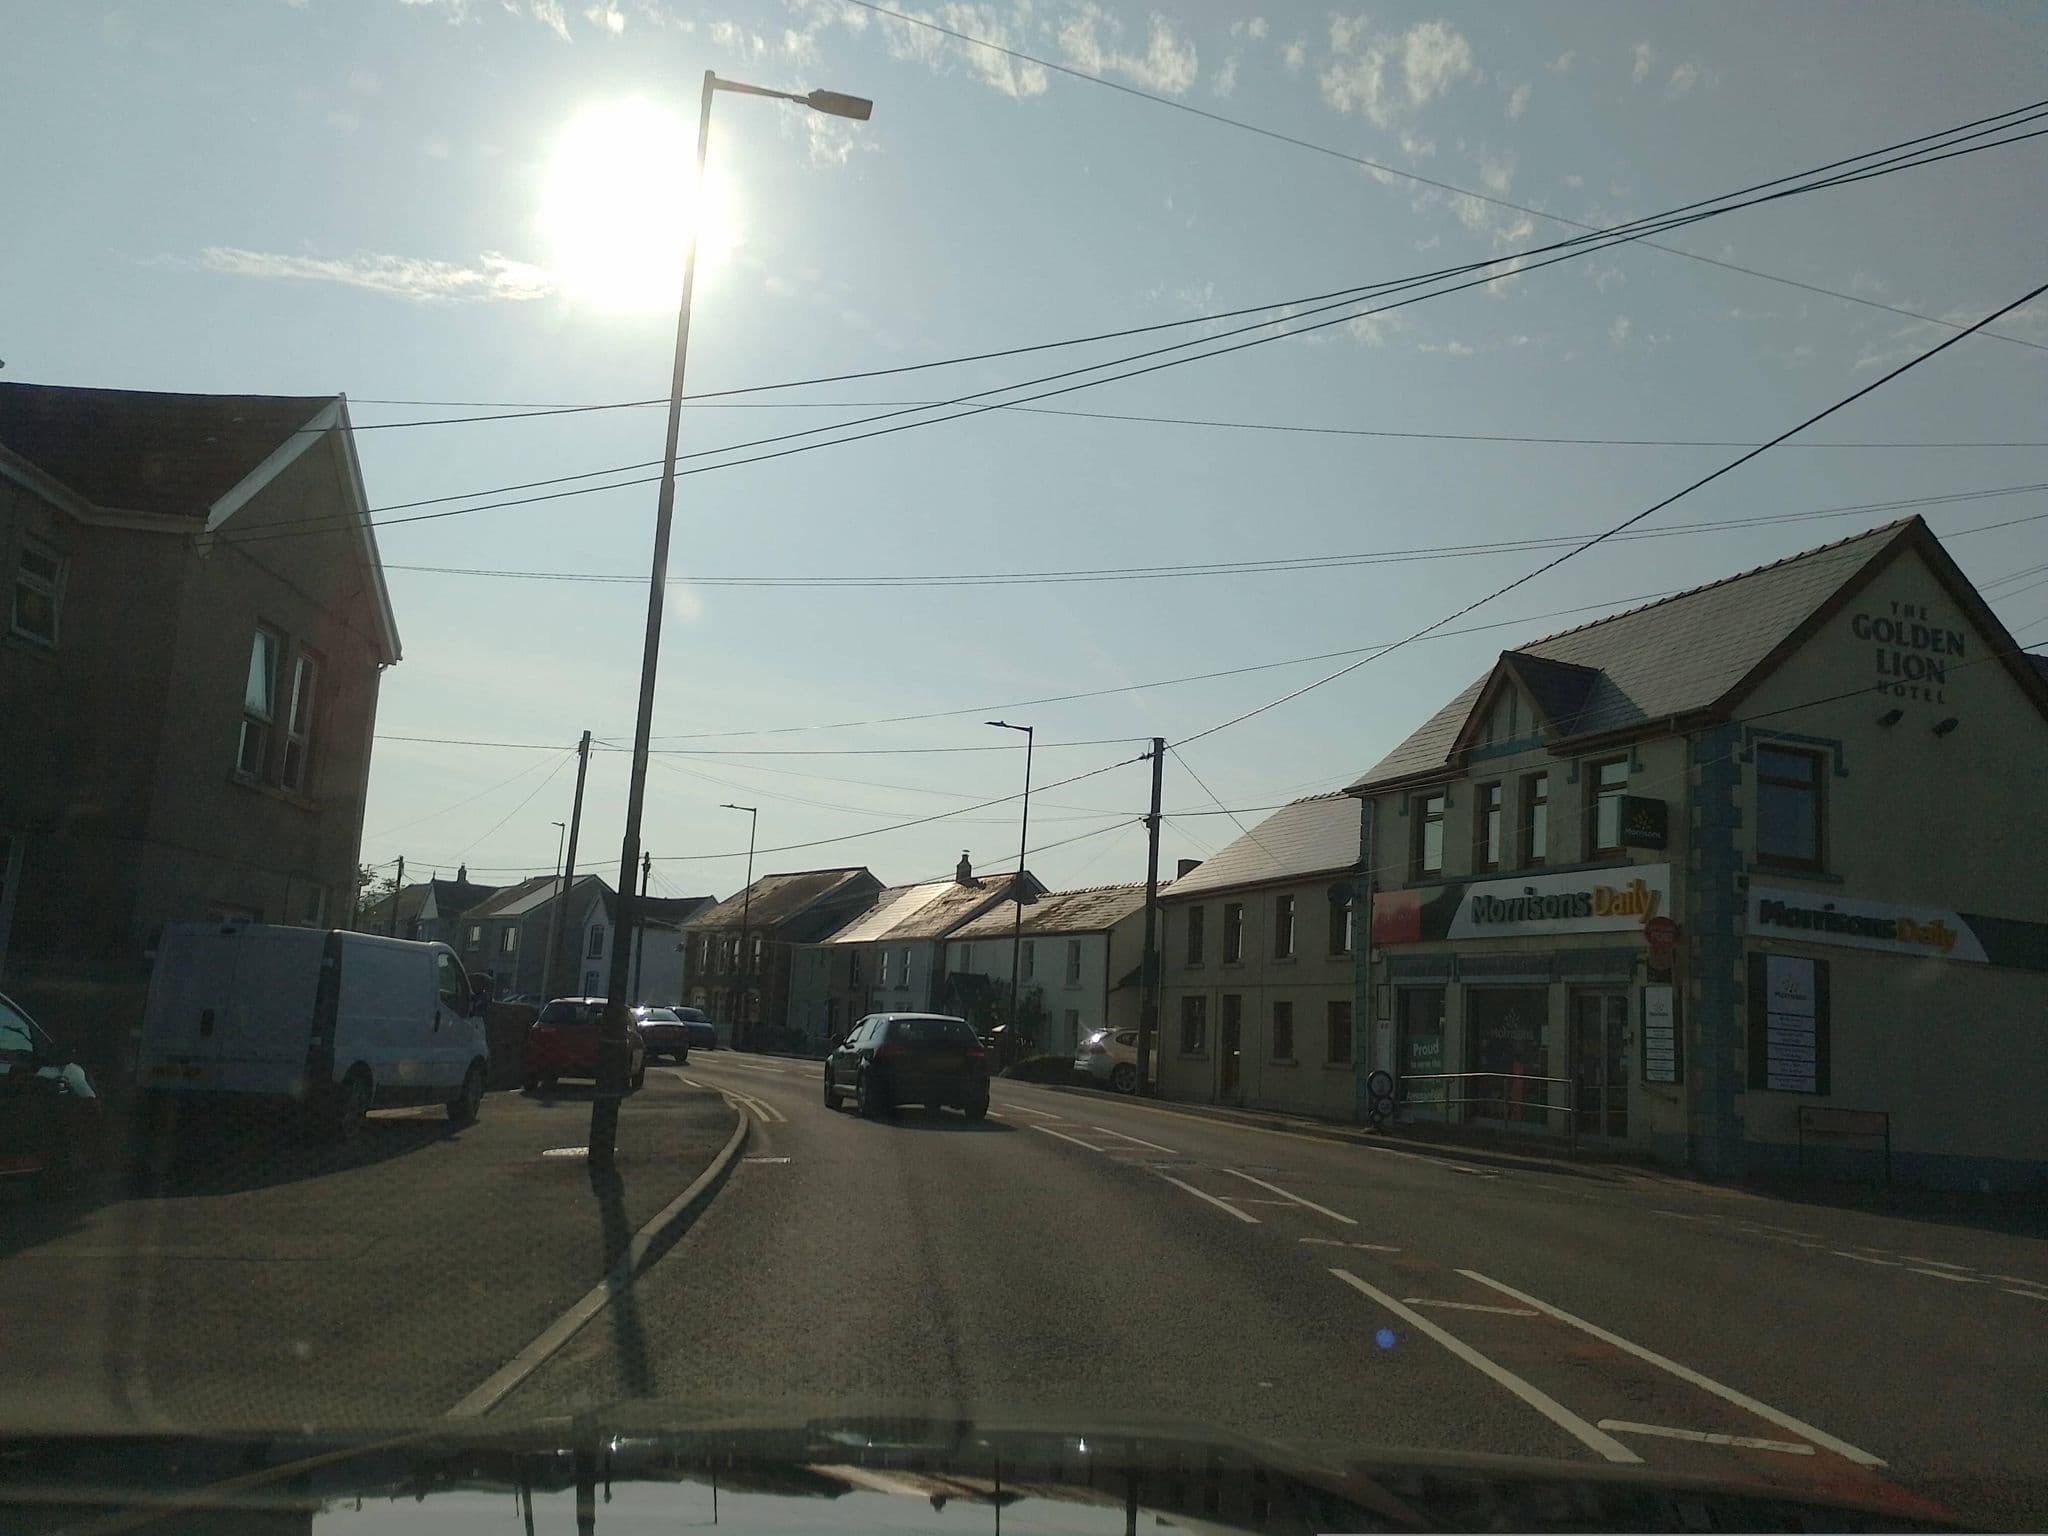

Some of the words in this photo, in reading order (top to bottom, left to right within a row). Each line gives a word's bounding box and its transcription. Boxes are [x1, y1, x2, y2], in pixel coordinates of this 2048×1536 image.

[1891, 601, 1928, 620] THE
[1852, 613, 1965, 657] GOLDEN
[1876, 648, 1945, 684] LION
[1877, 679, 1945, 705] HOTEL
[1471, 886, 1591, 924] Morrisons
[1591, 878, 1662, 923] Daily
[1760, 899, 1897, 939] Morrisons
[1897, 917, 1958, 952] Daily
[1413, 1039, 1440, 1057] Proud
